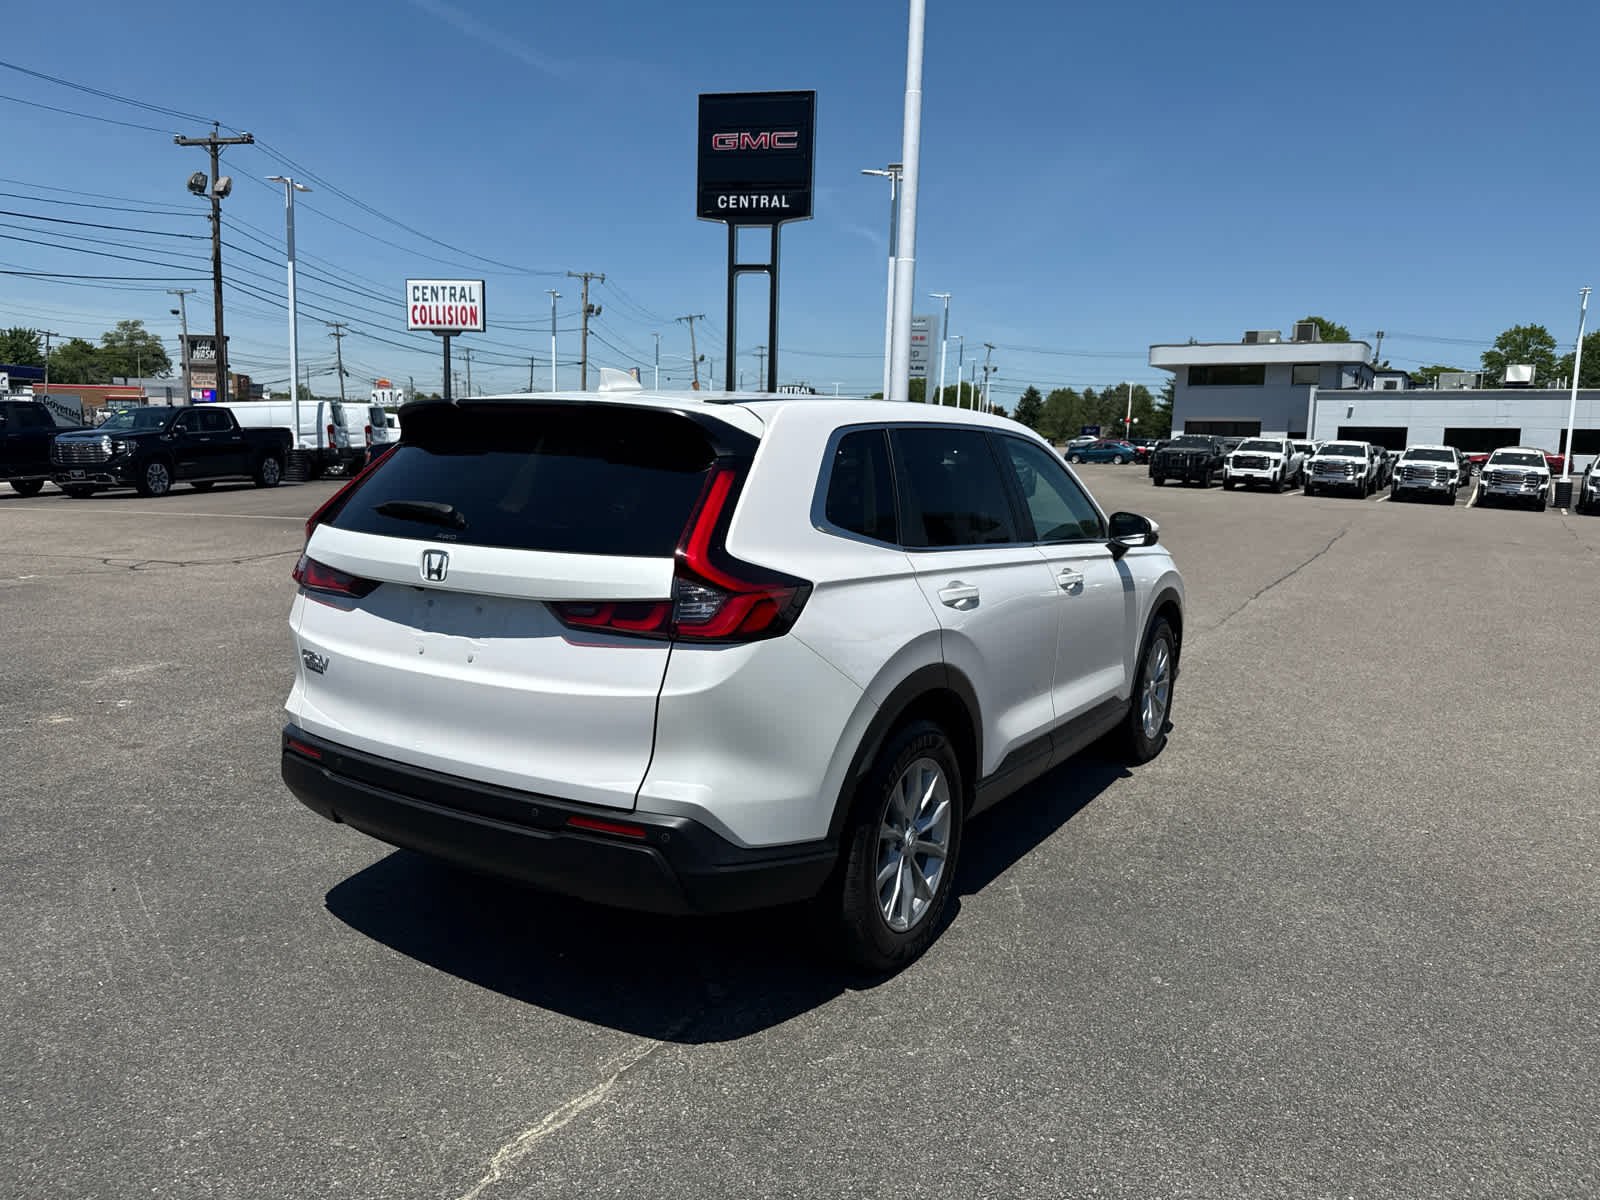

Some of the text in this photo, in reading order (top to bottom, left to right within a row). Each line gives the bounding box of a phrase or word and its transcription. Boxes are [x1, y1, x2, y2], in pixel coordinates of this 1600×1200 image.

[712, 131, 798, 150] GMC
[717, 194, 790, 209] CENTRAL
[412, 285, 476, 303] CENTRAL
[411, 304, 478, 326] COLLISION
[192, 349, 217, 360] WASH
[776, 385, 811, 395] ENTRAL
